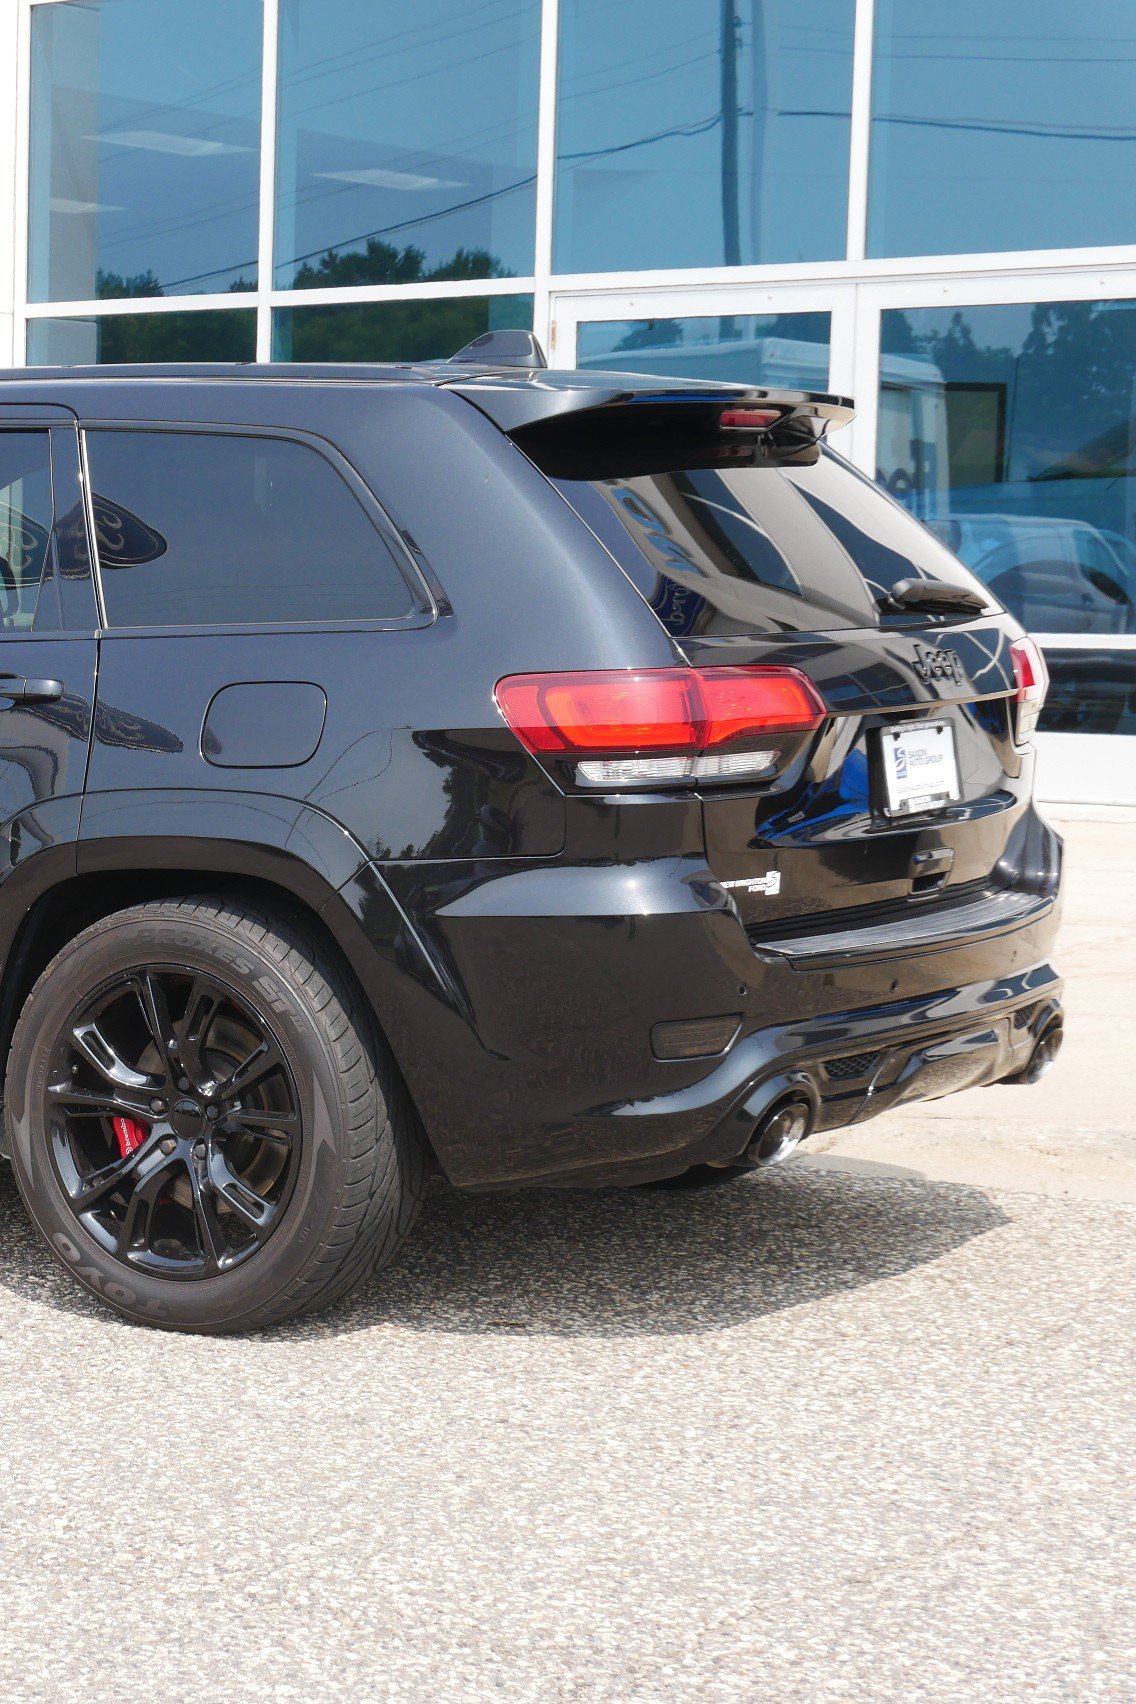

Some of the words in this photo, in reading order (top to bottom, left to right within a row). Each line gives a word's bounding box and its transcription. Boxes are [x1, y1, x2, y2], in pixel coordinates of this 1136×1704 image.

[911, 643, 964, 687] Jeep
[135, 928, 256, 975] PROXES
[51, 1231, 168, 1317] TOYO
